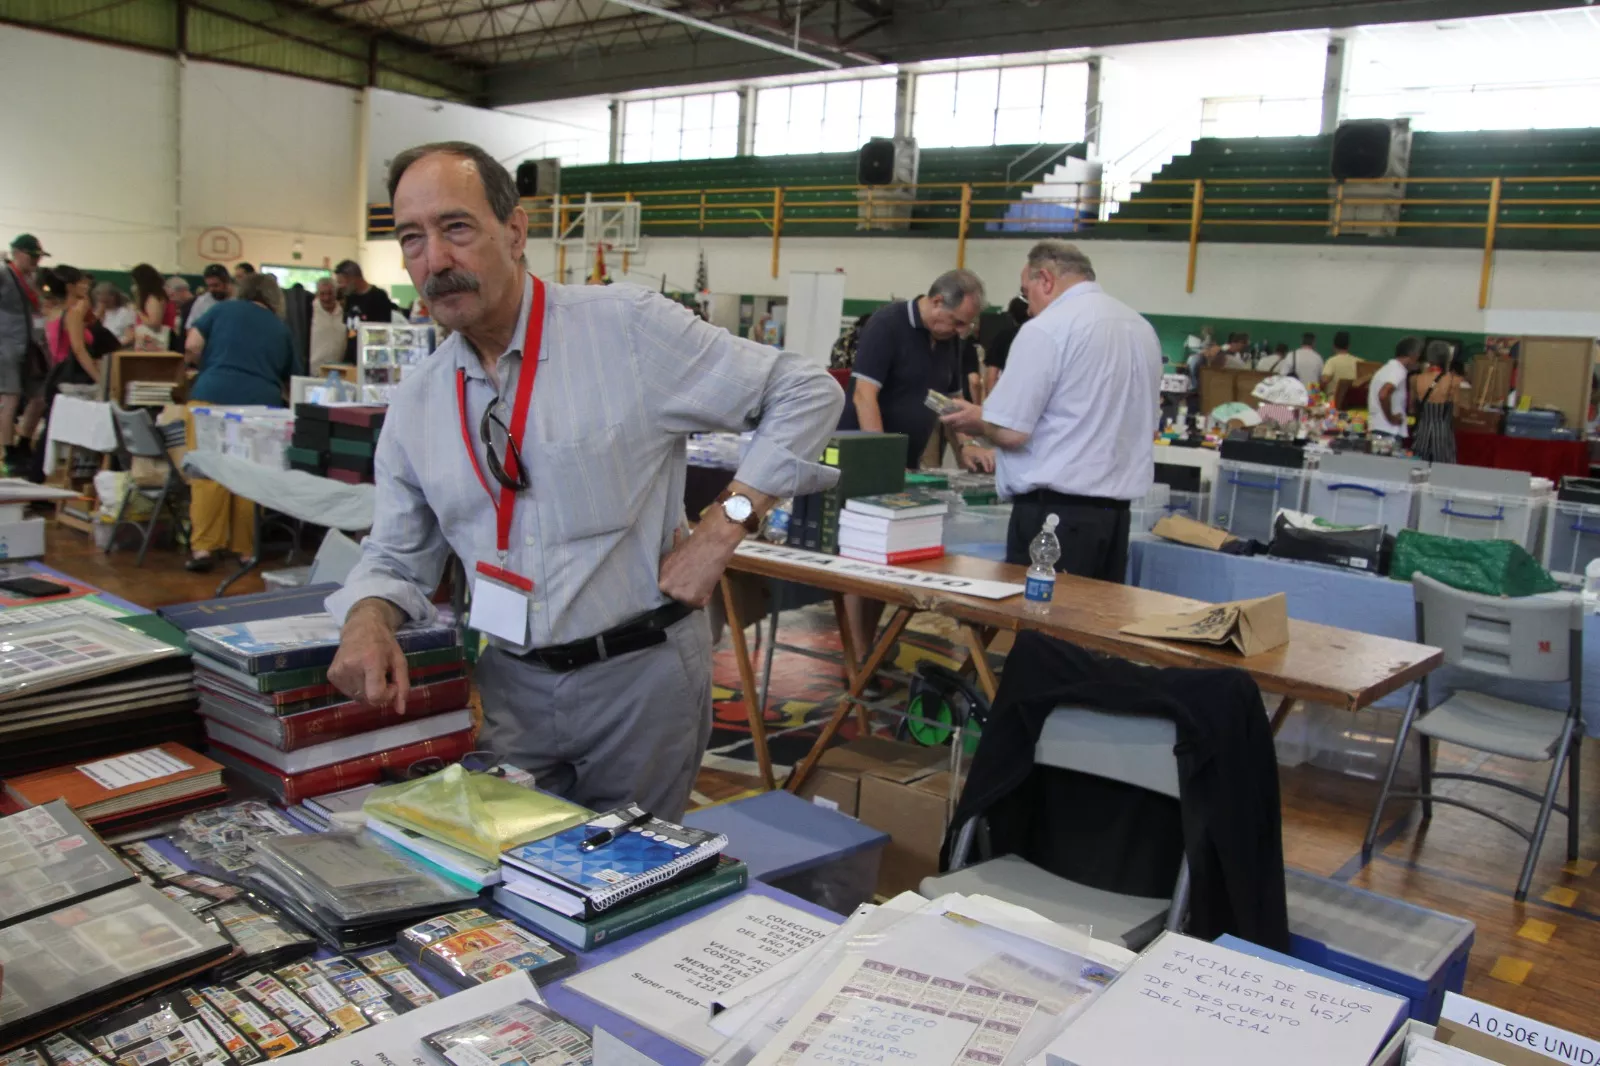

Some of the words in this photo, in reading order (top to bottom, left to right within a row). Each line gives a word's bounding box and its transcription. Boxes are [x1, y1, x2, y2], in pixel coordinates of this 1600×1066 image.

[736, 927, 757, 940] DEL
[745, 915, 787, 933] SELLOS
[709, 941, 747, 958] VALOR
[756, 944, 787, 958] 1992
[681, 956, 723, 976] MENOS
[722, 973, 737, 982] EL
[720, 963, 752, 978] PTAS
[631, 972, 664, 990] Super
[1172, 950, 1265, 984] FACIALES
[1272, 979, 1299, 993] DE
[1303, 990, 1373, 1014] SELLOS
[1143, 973, 1174, 989] DE
[1183, 987, 1301, 1027] DESCUENTO
[1162, 962, 1188, 976] EN
[1280, 999, 1297, 1010] EL
[1309, 1003, 1353, 1025] 45%
[867, 1005, 938, 1028] PLIEGO
[1140, 988, 1183, 1008] DEL
[1195, 1005, 1271, 1035] FACIAL
[852, 1026, 901, 1042] SELLOS
[1467, 1012, 1481, 1028] A
[1486, 1017, 1539, 1047] 0,50€
[823, 1042, 884, 1063] LENGUA
